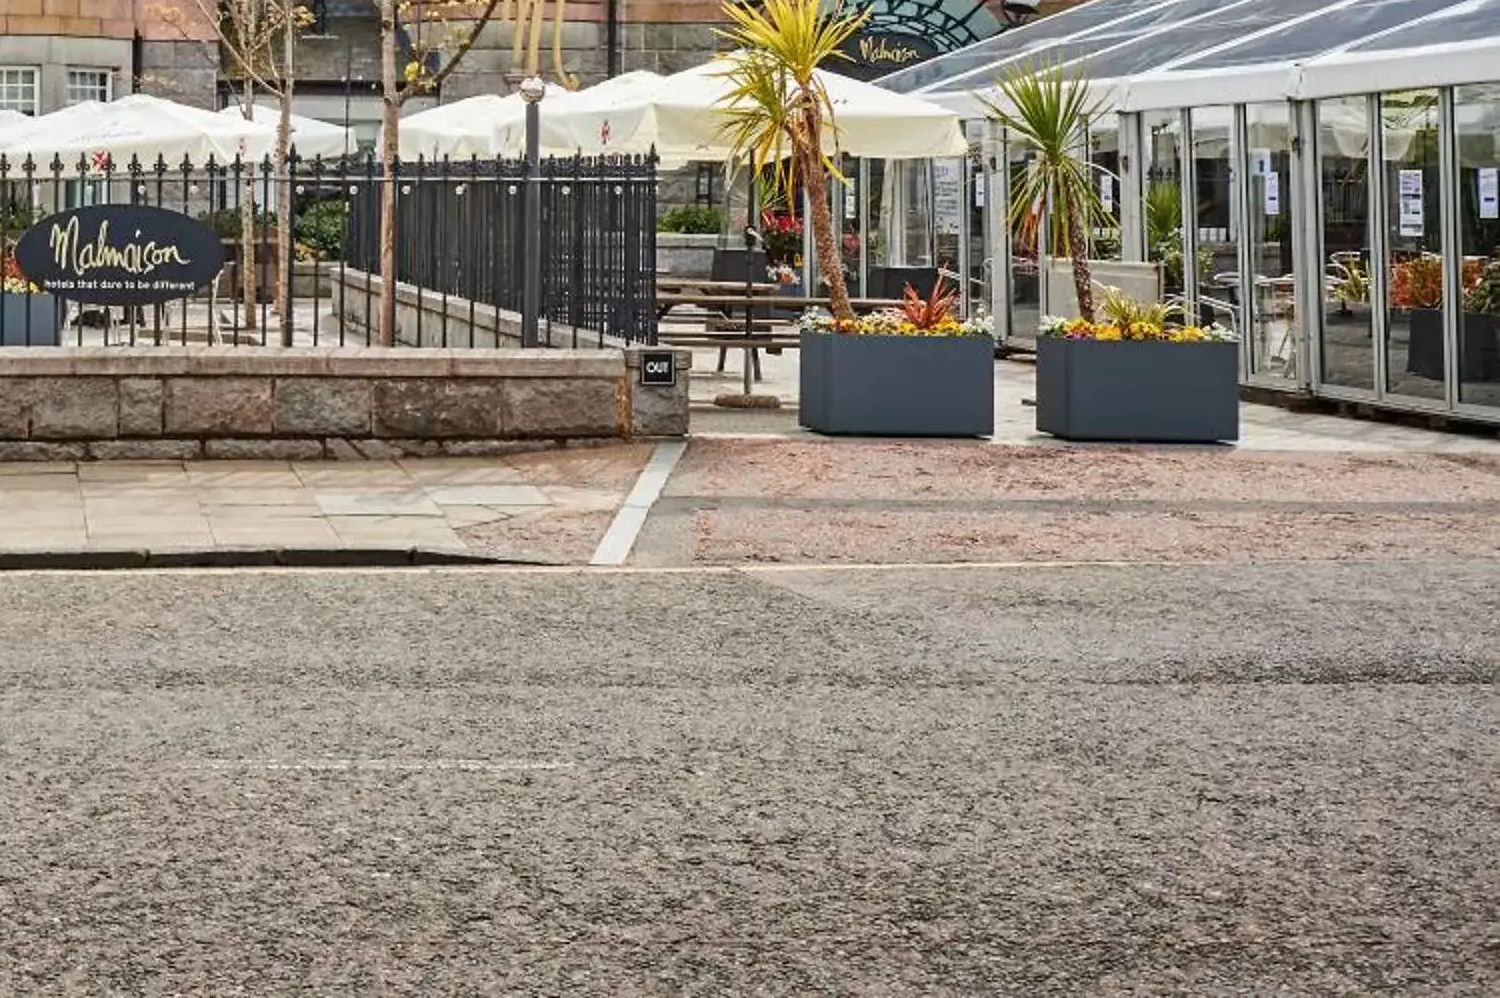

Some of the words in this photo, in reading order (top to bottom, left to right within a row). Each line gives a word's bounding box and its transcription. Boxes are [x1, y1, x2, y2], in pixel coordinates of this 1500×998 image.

[859, 35, 921, 64] Malmaison
[49, 214, 192, 276] Malmaison
[43, 279, 75, 290] hotels
[77, 279, 98, 290] that
[100, 279, 123, 290] dare
[125, 279, 135, 290] to
[137, 279, 150, 290] be
[152, 279, 196, 291] different
[645, 361, 669, 373] OUT
